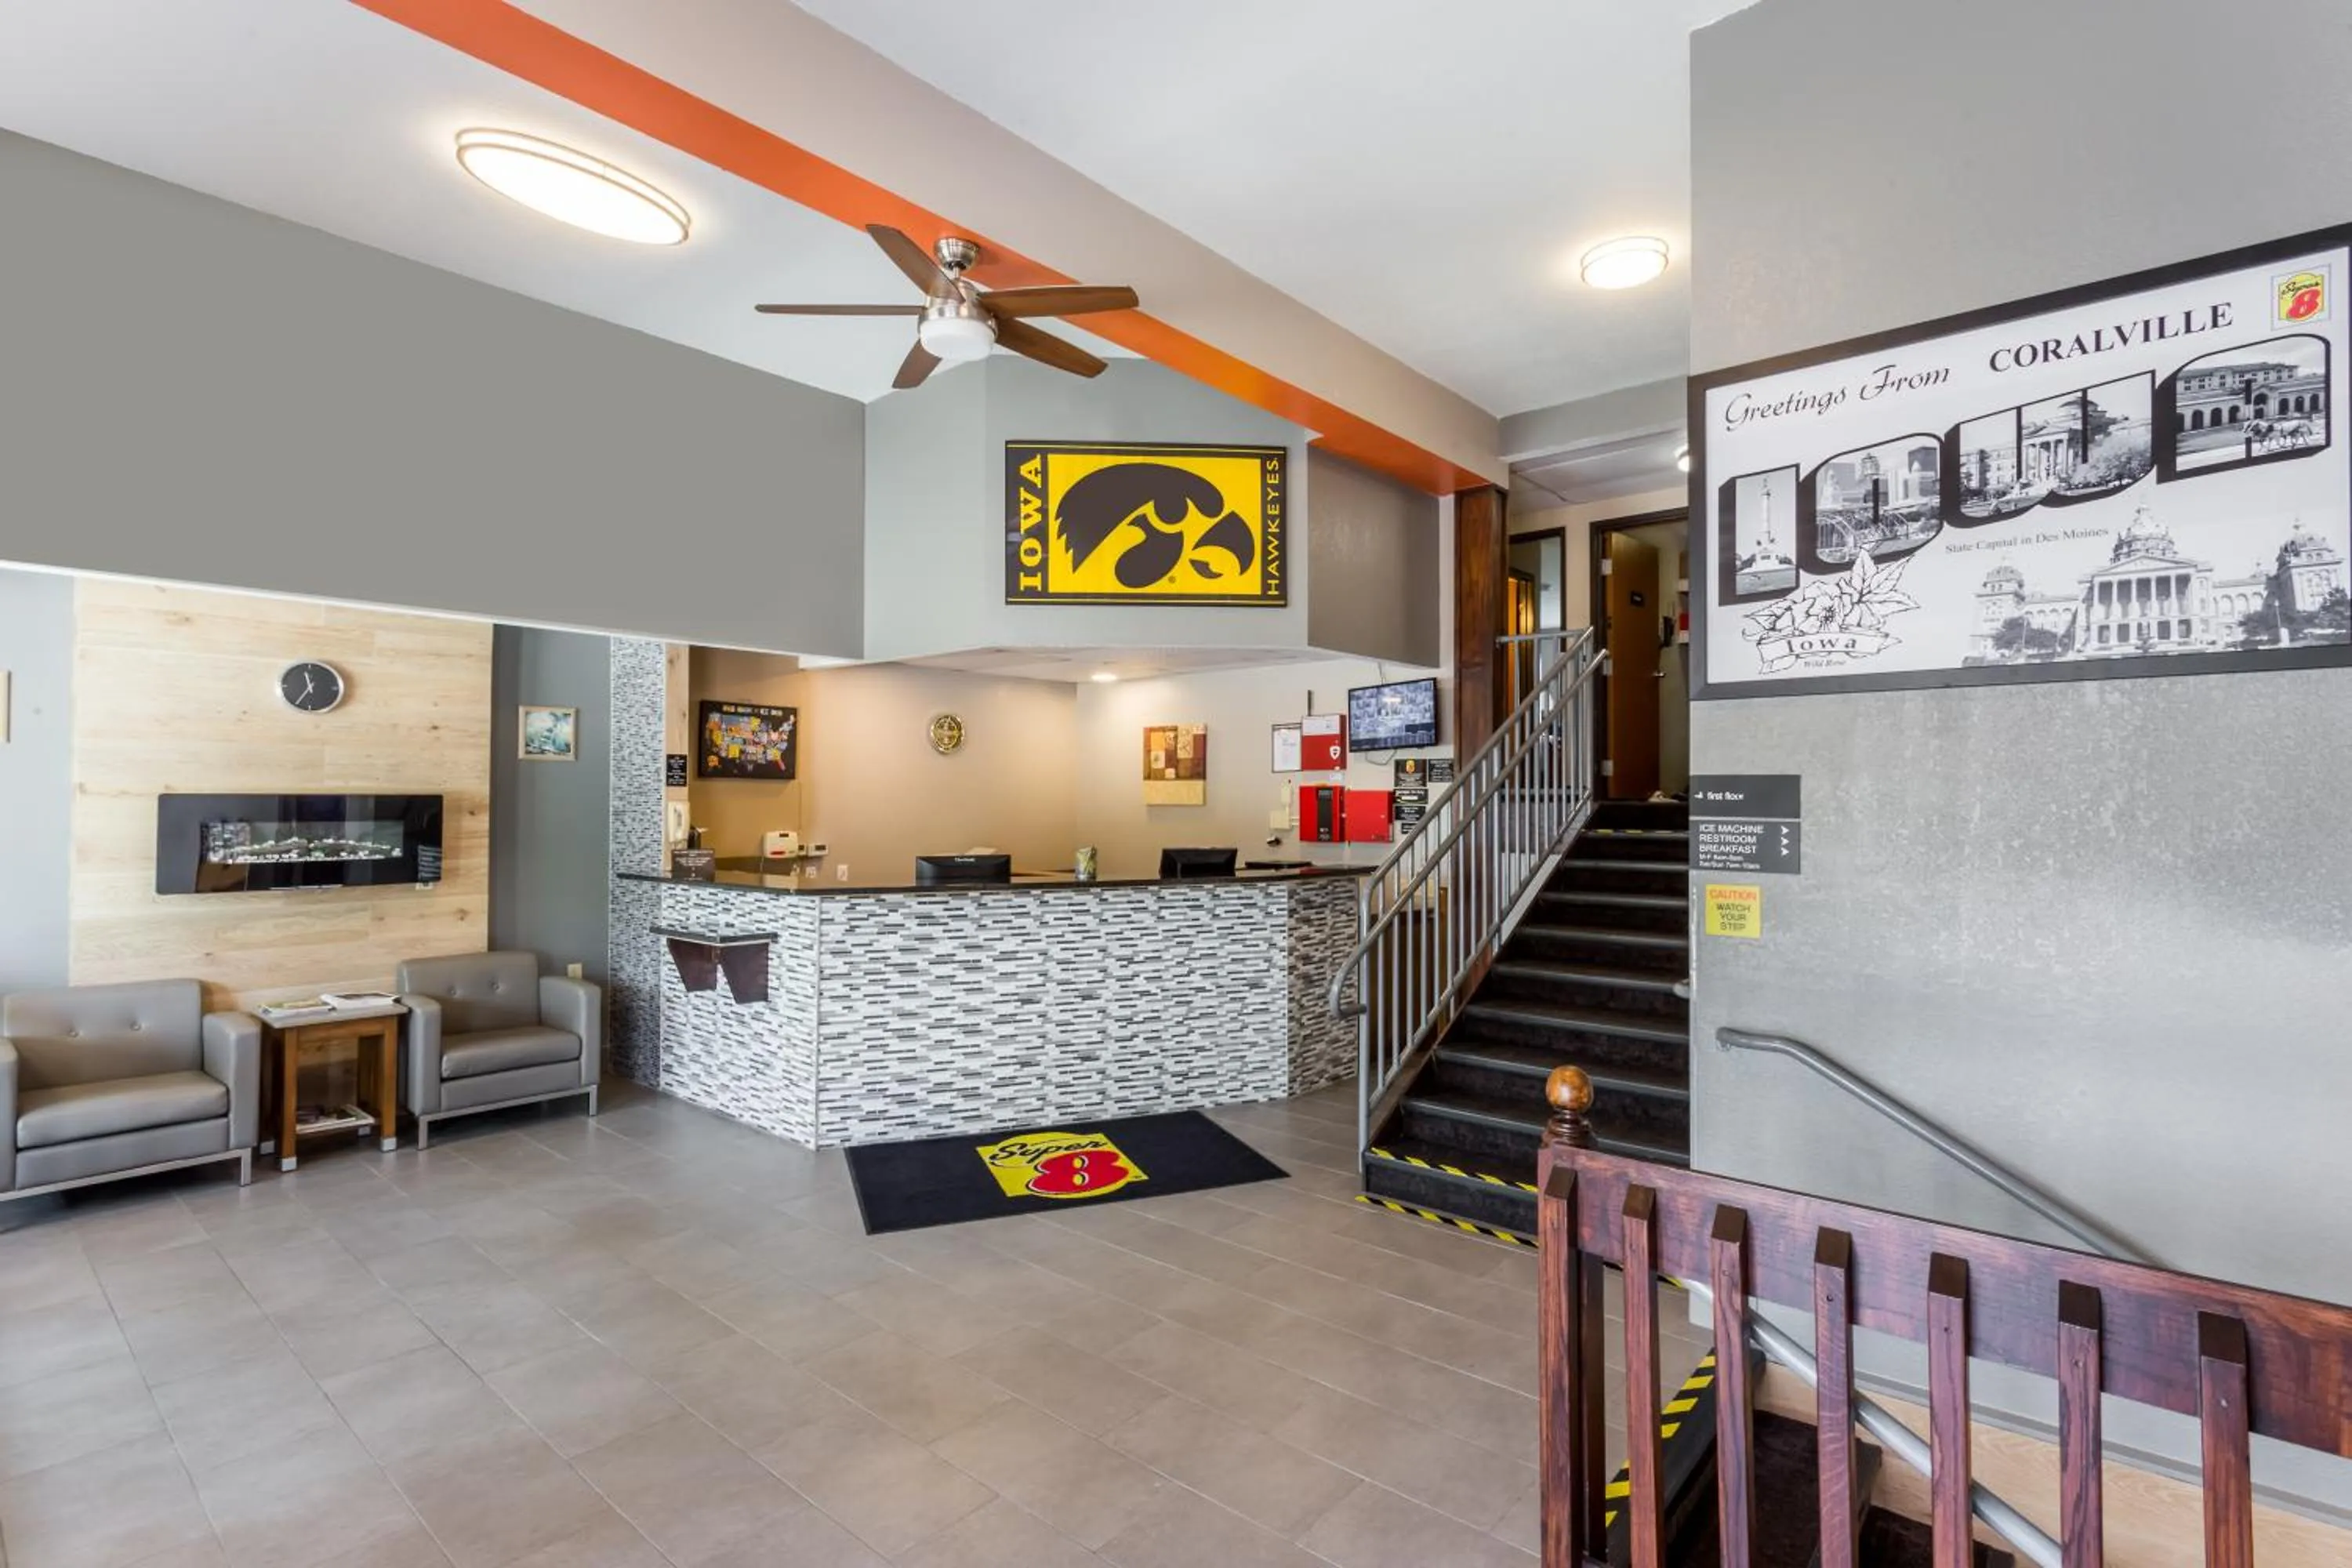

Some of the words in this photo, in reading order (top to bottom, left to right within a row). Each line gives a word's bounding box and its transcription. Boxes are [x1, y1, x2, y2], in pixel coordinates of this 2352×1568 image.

[2286, 286, 2322, 321] 8
[1725, 386, 1848, 434] Greetings
[1860, 363, 1951, 403] From
[1989, 301, 2234, 374] CORALVILLE
[1719, 334, 2332, 607] IOWA
[1019, 453, 1043, 592] IOWA
[1266, 456, 1280, 596] HAWKEYES
[1945, 544, 1973, 554] State
[2020, 536, 2032, 545] in
[2035, 532, 2059, 543] Des
[2062, 528, 2109, 540] Moines
[1786, 637, 1858, 654] Iowa
[1707, 791, 1722, 800] first
[1724, 791, 1744, 800] floor
[1699, 824, 1715, 833] ICE
[1718, 825, 1764, 834] MACHINE
[1699, 833, 1757, 844] RESTROOM
[1699, 844, 1757, 855] BREAKFAST
[1709, 889, 1756, 901] CAUTION
[1716, 903, 1751, 913] WATCH
[1719, 912, 1747, 921] YOUR
[1719, 921, 1747, 931] STEP
[989, 1139, 1108, 1168] Super
[1025, 1149, 1130, 1194] 8
